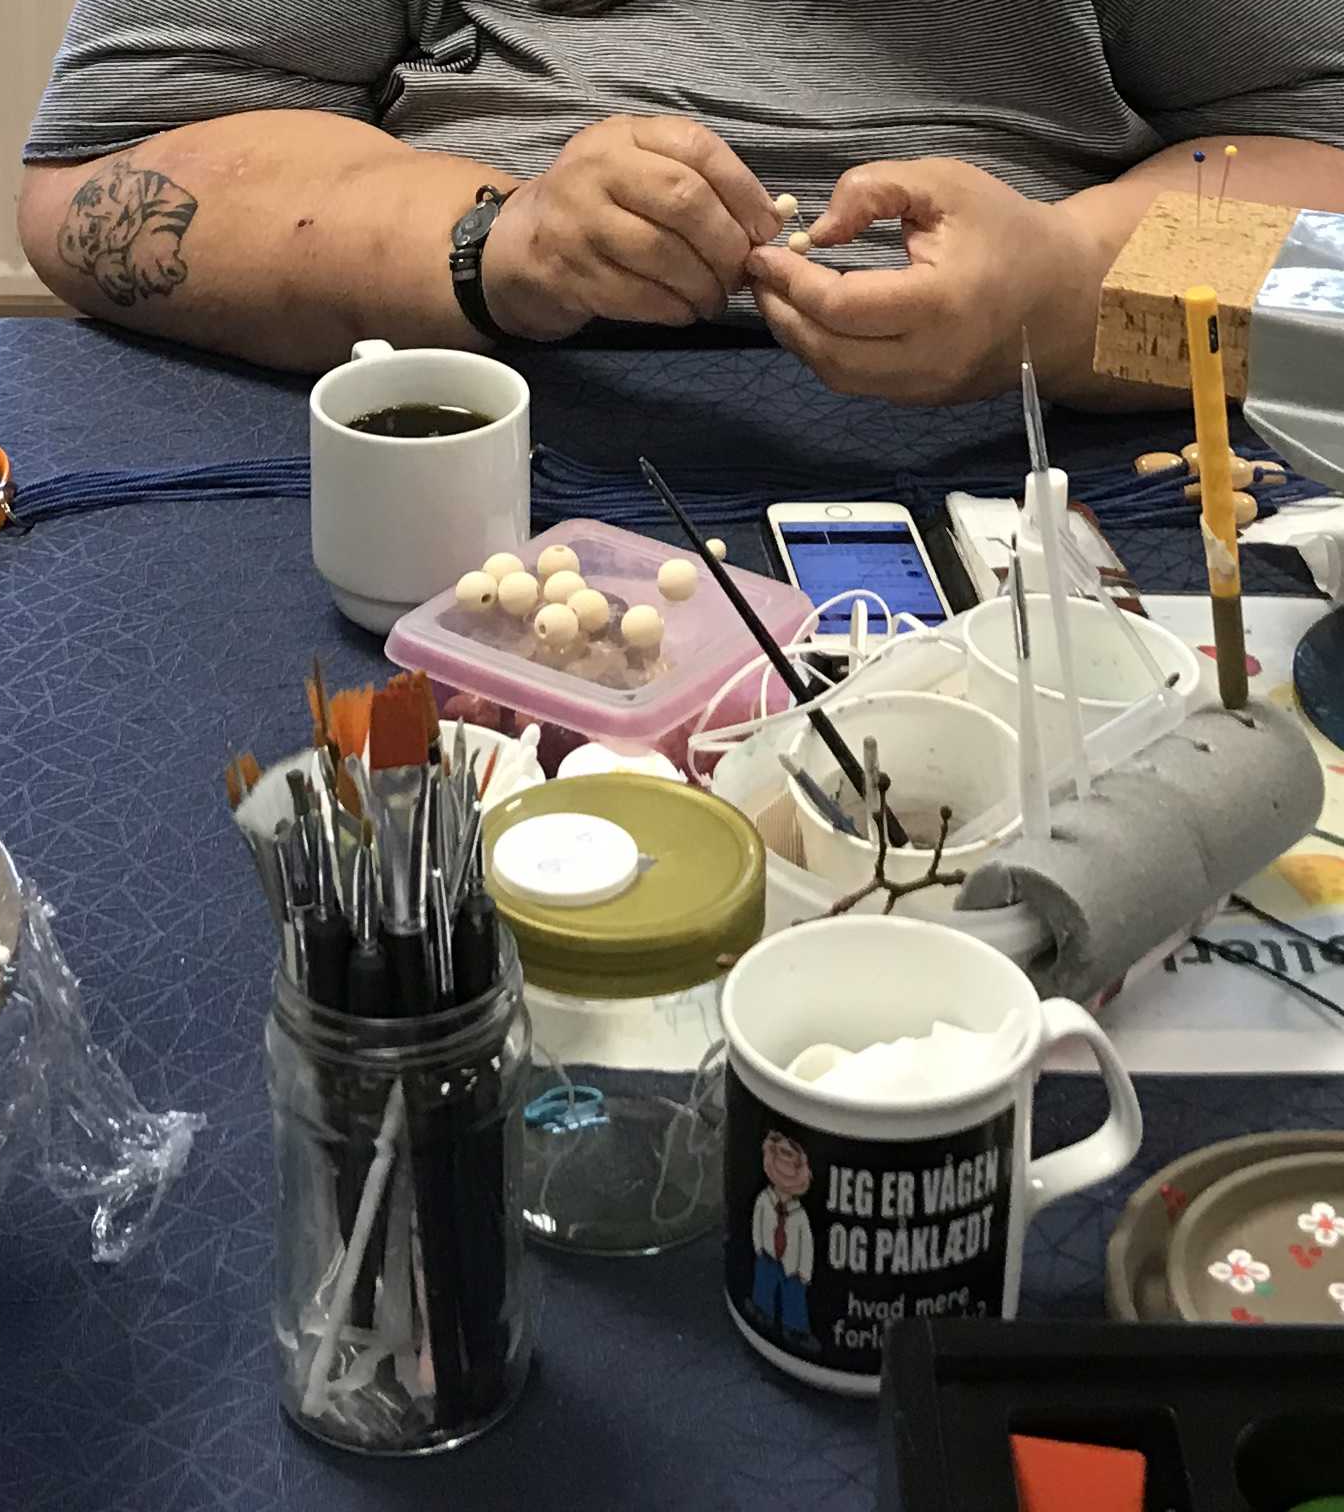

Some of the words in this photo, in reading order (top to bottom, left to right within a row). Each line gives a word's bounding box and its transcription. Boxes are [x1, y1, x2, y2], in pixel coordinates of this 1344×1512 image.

[826, 1164, 874, 1219] JEG
[880, 1170, 915, 1219] ER
[922, 1145, 999, 1216] VÅGEN
[828, 1221, 868, 1274] OG
[874, 1204, 995, 1275] PÅKLÆDT
[847, 1290, 905, 1321] hvad
[915, 1286, 970, 1316] mere
